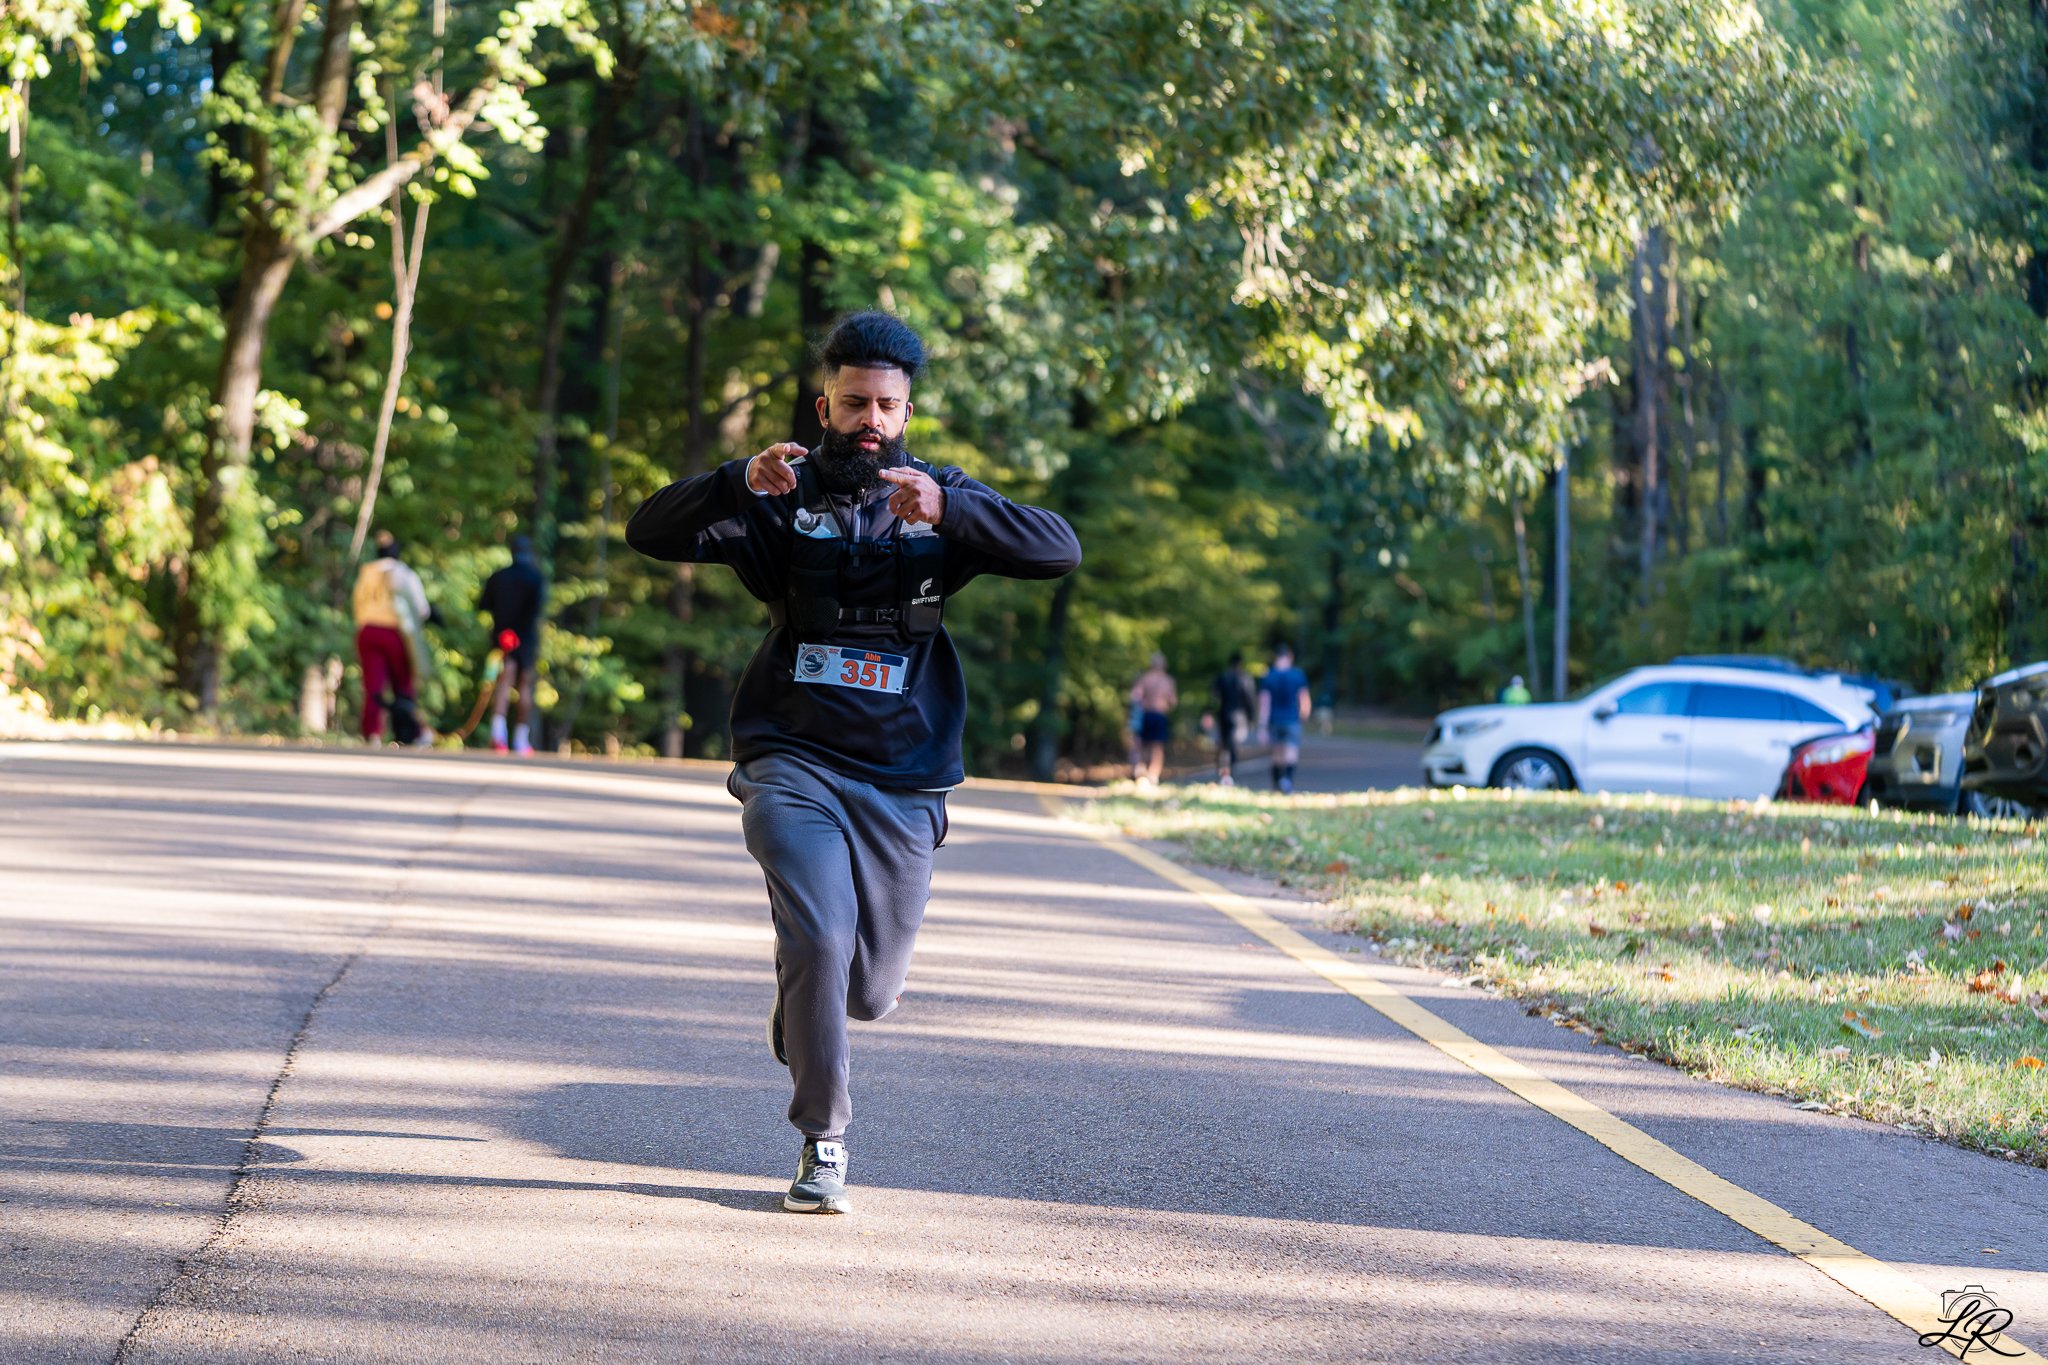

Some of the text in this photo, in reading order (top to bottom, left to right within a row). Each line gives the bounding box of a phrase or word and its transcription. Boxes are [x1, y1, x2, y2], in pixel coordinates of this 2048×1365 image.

[911, 595, 941, 605] SWIFTVEST
[864, 652, 881, 662] Abin
[840, 659, 890, 689] 351
